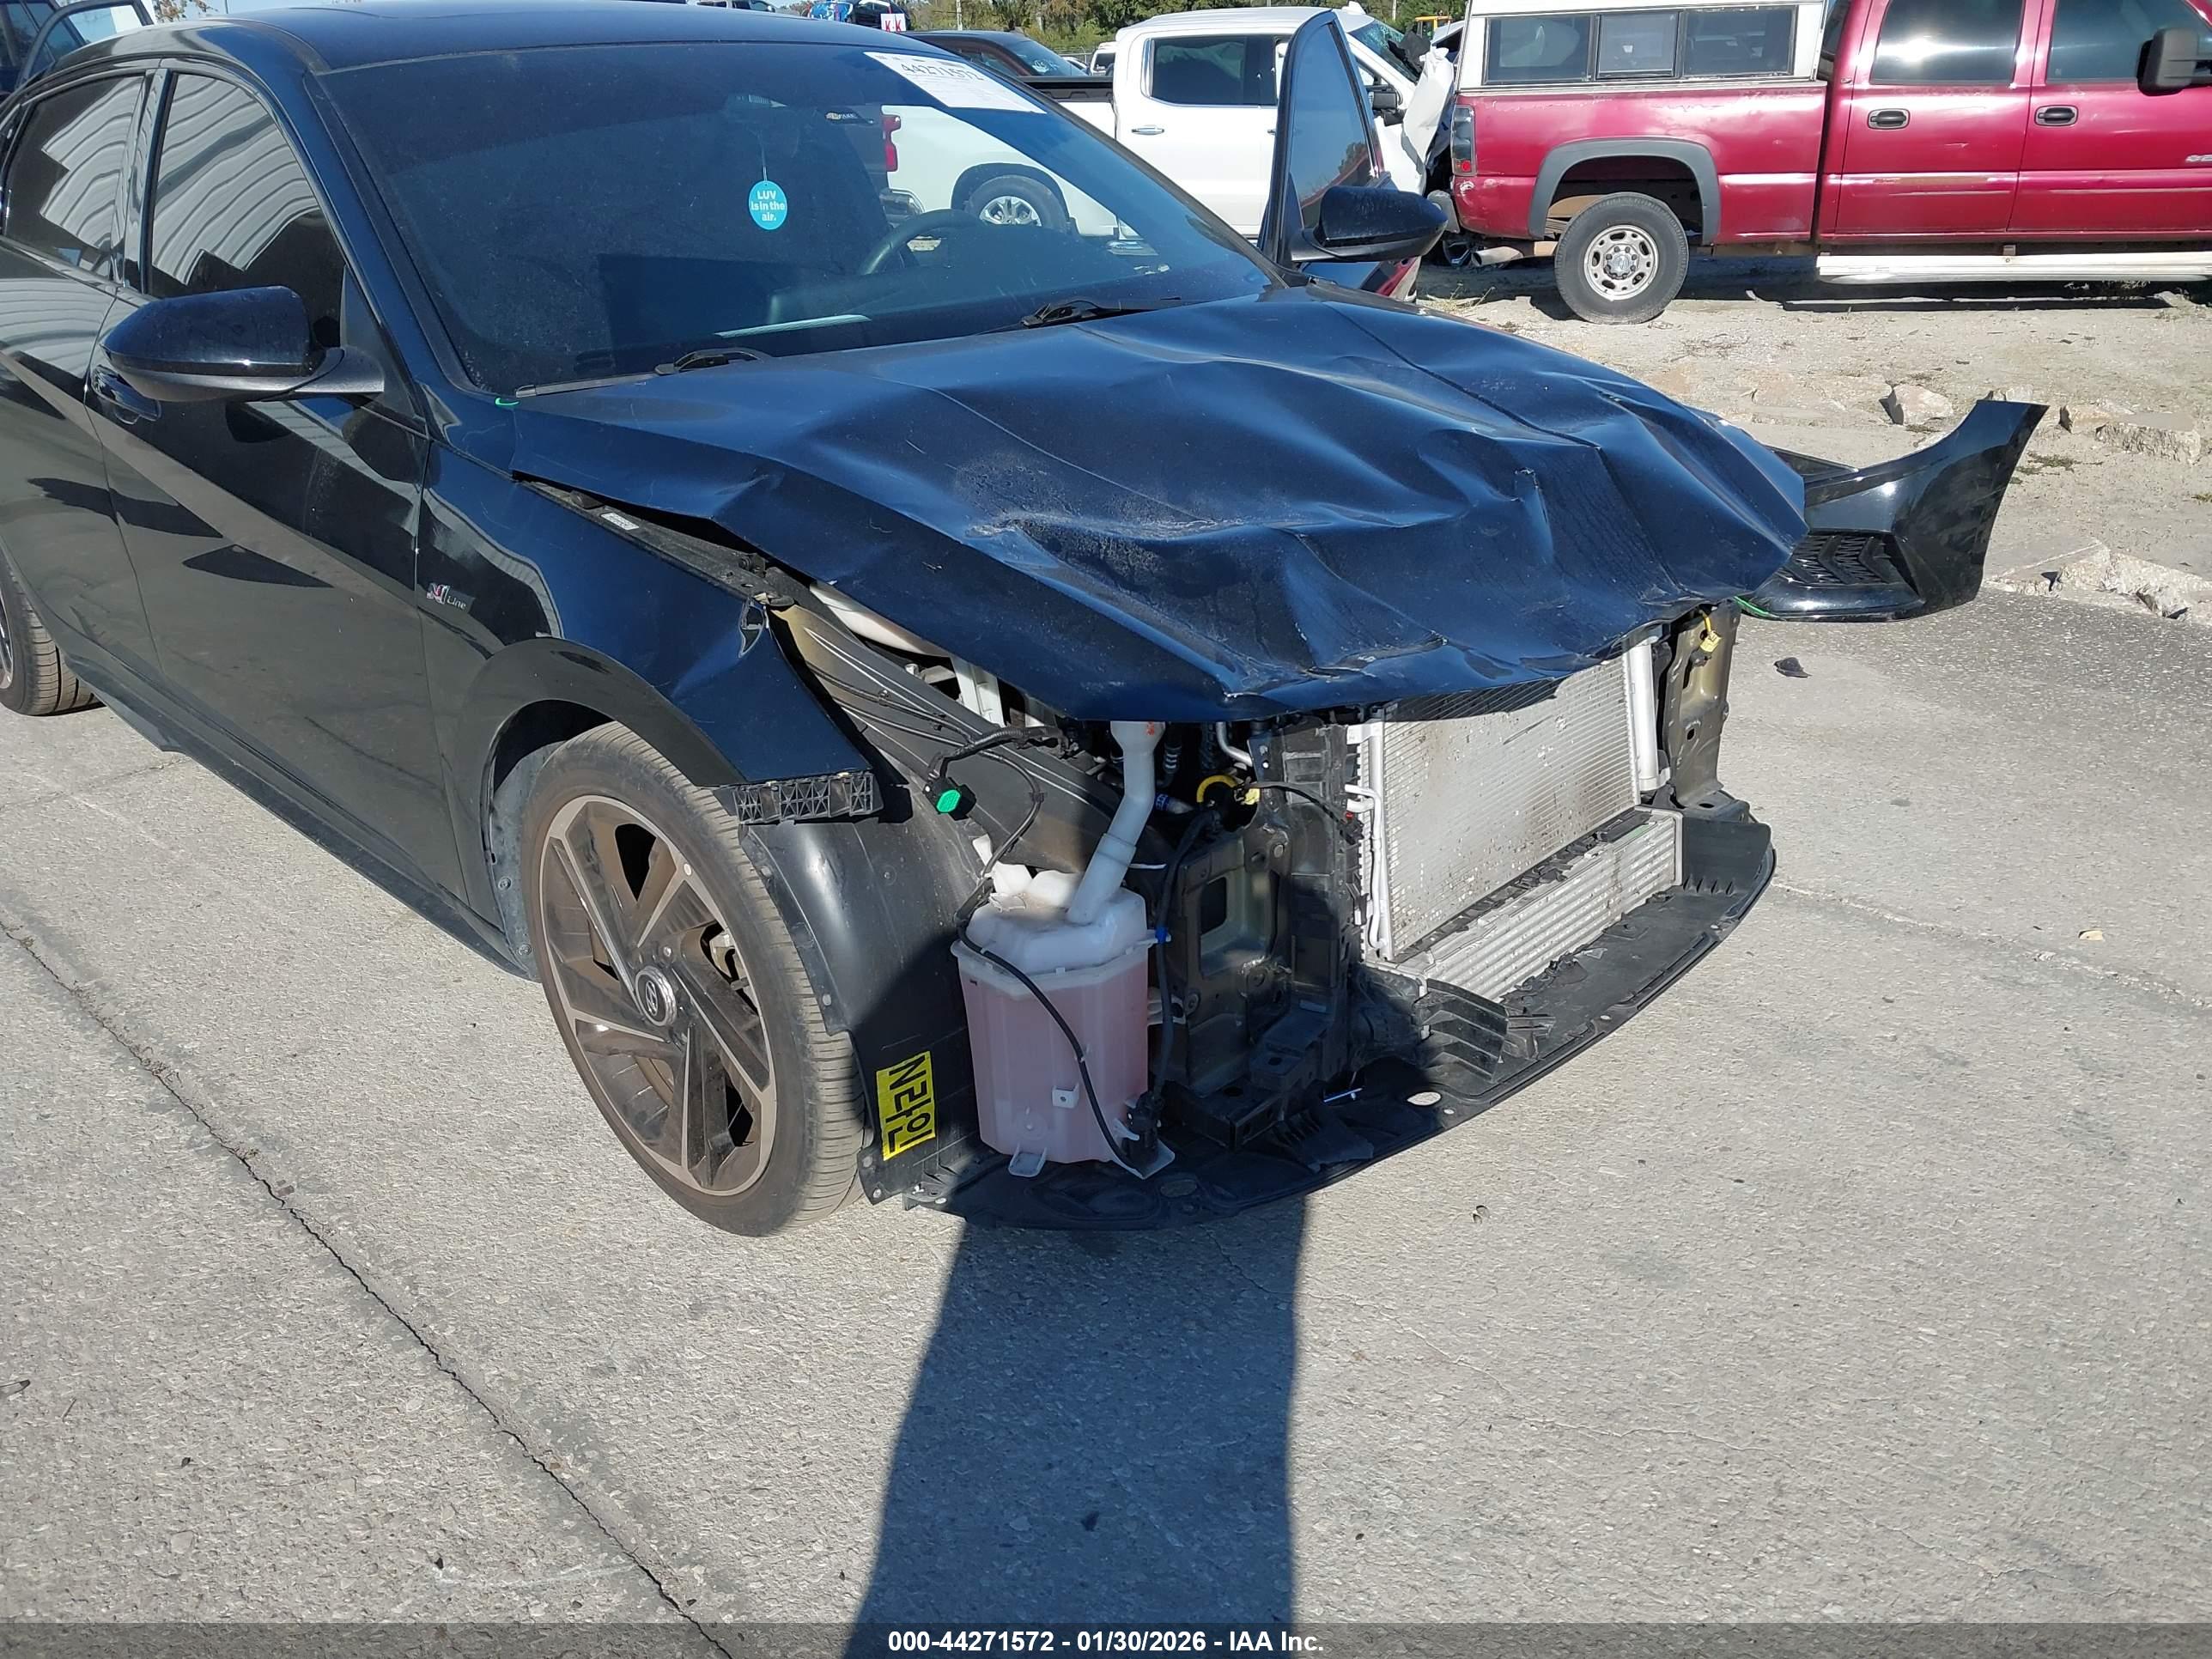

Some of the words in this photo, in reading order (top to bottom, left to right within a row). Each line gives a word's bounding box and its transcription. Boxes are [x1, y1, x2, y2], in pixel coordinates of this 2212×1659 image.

[901, 64, 984, 81] 44271572
[757, 190, 776, 200] LUV
[769, 201, 786, 210] the
[762, 211, 777, 222] air.
[447, 595, 466, 610] Line
[885, 1054, 933, 1154] N라인
